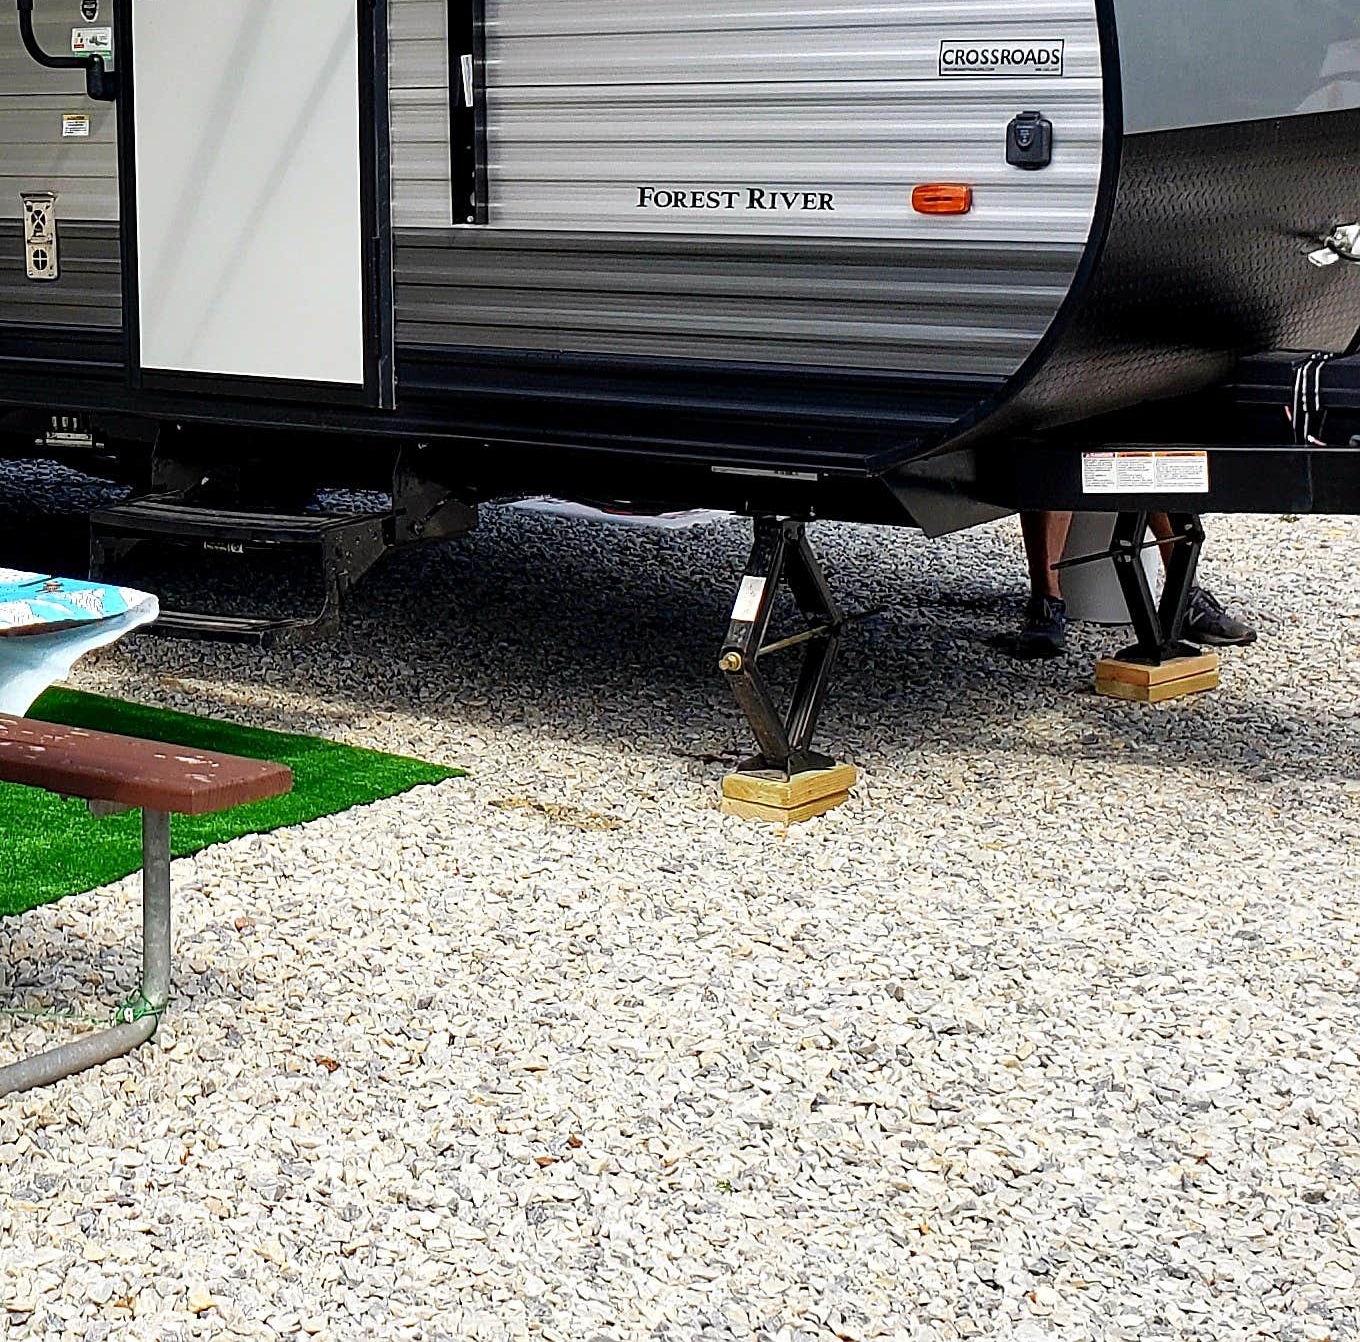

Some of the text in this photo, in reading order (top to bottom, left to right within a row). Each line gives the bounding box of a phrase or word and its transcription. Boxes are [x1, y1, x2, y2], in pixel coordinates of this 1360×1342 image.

[942, 49, 1060, 65] CROSSROADS
[636, 186, 835, 211] FOREST RIVER
